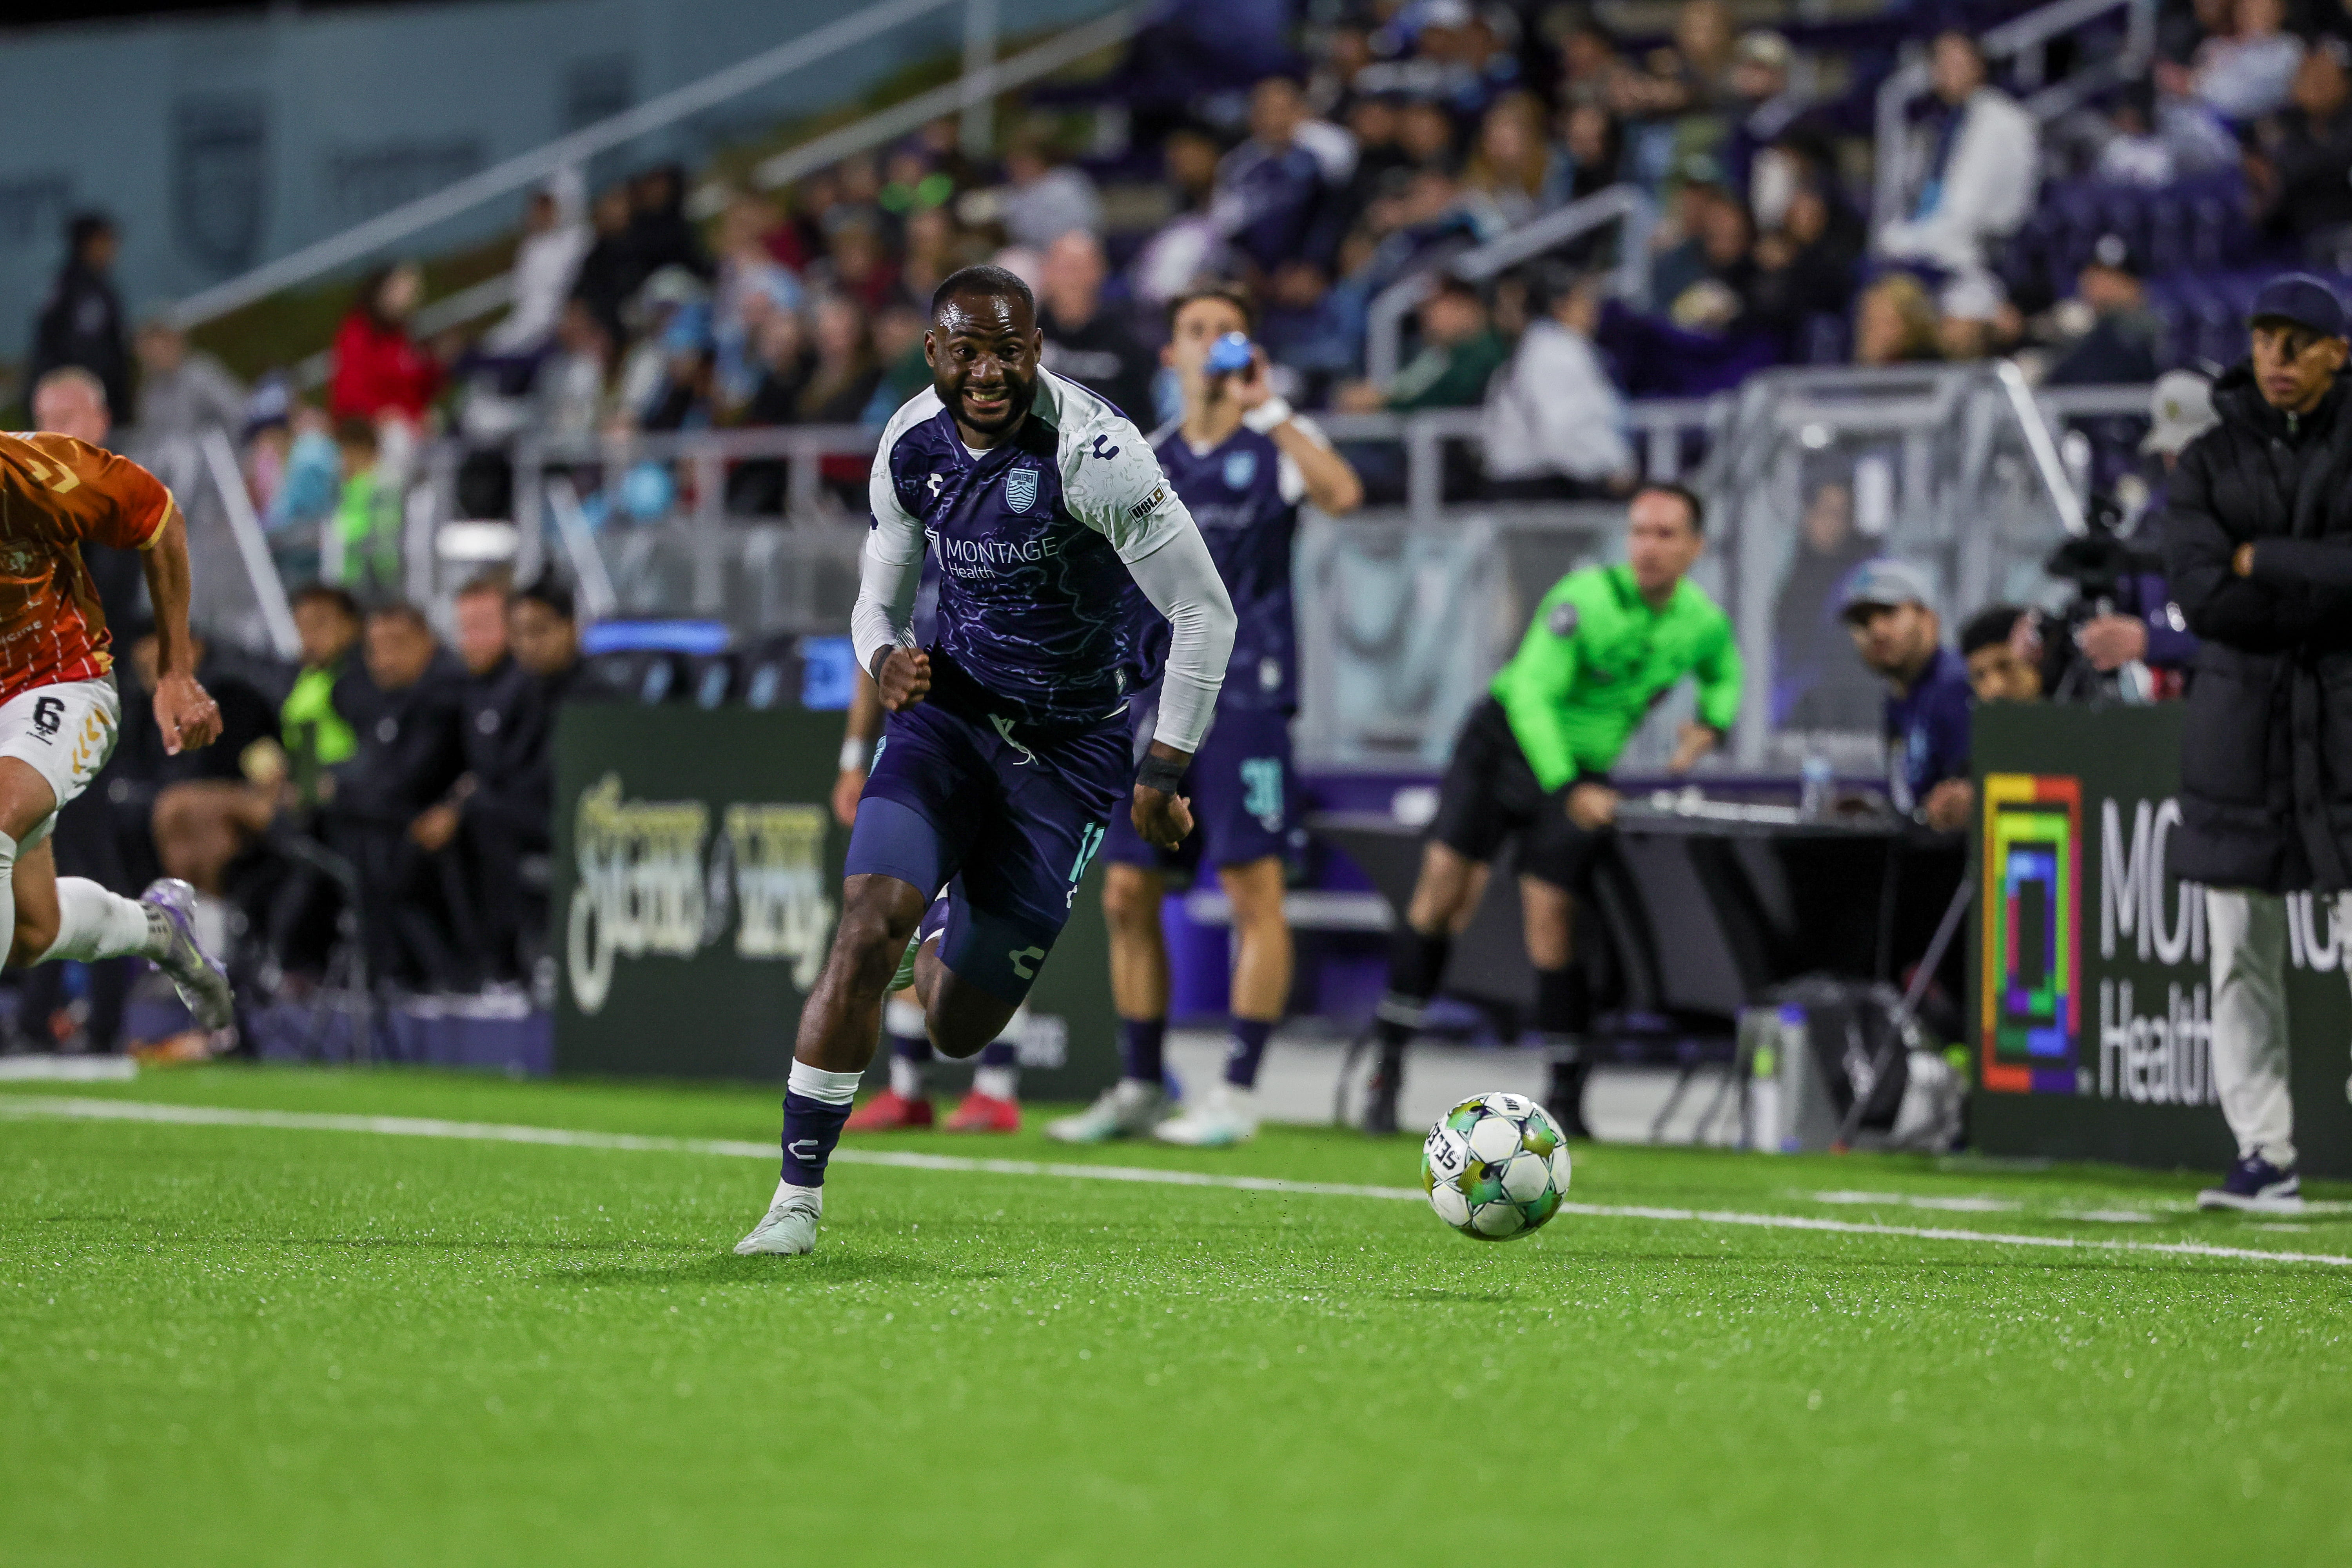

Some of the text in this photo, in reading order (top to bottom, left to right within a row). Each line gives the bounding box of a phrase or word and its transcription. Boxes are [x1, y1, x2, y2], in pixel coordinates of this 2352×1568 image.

[1131, 497, 1158, 518] USL
[946, 536, 1059, 564] MONTAGE
[948, 561, 996, 579] Health
[33, 696, 65, 733] 6
[2100, 975, 2220, 1105] Health
